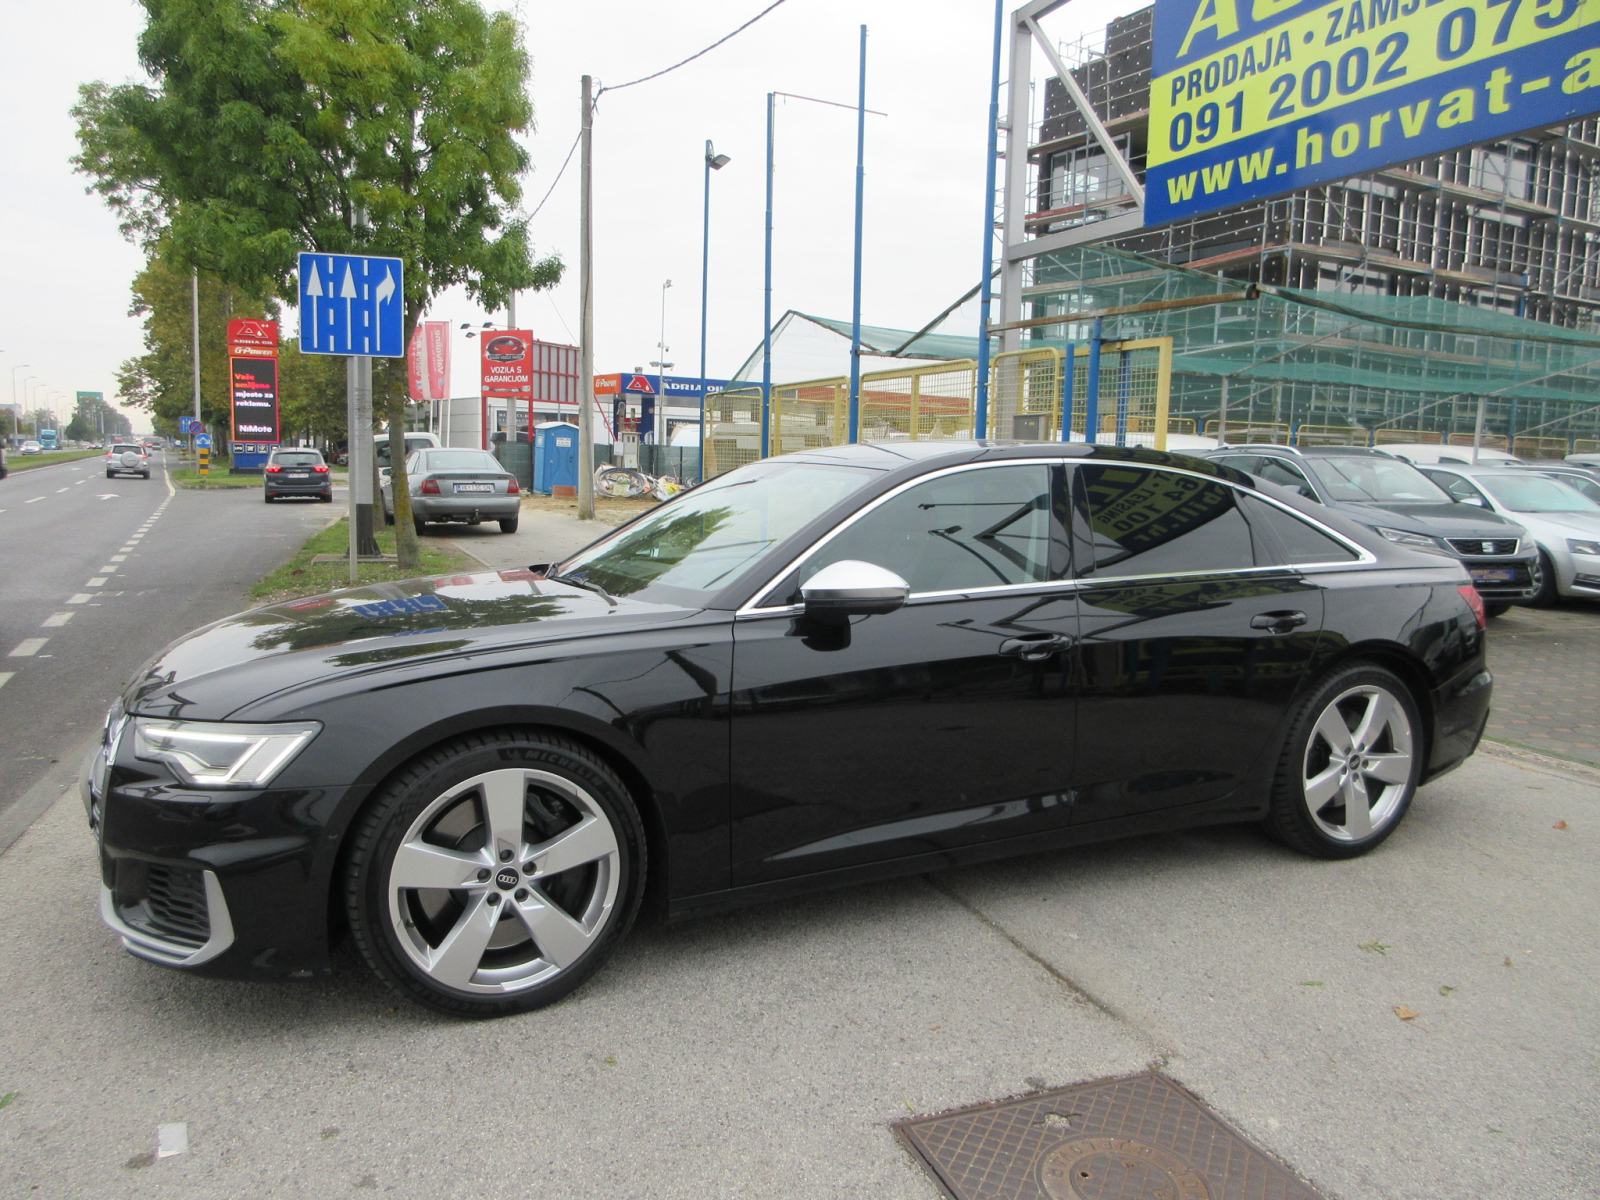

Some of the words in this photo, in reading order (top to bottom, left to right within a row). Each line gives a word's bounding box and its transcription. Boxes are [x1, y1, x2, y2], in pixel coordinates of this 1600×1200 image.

[1169, 90, 1244, 153] 091
[1267, 31, 1409, 122] 2002
[1170, 30, 1292, 107] PRODAJA
[1325, 0, 1449, 47] ZAMJ
[490, 366, 515, 374] VOZILA
[516, 366, 523, 374] S
